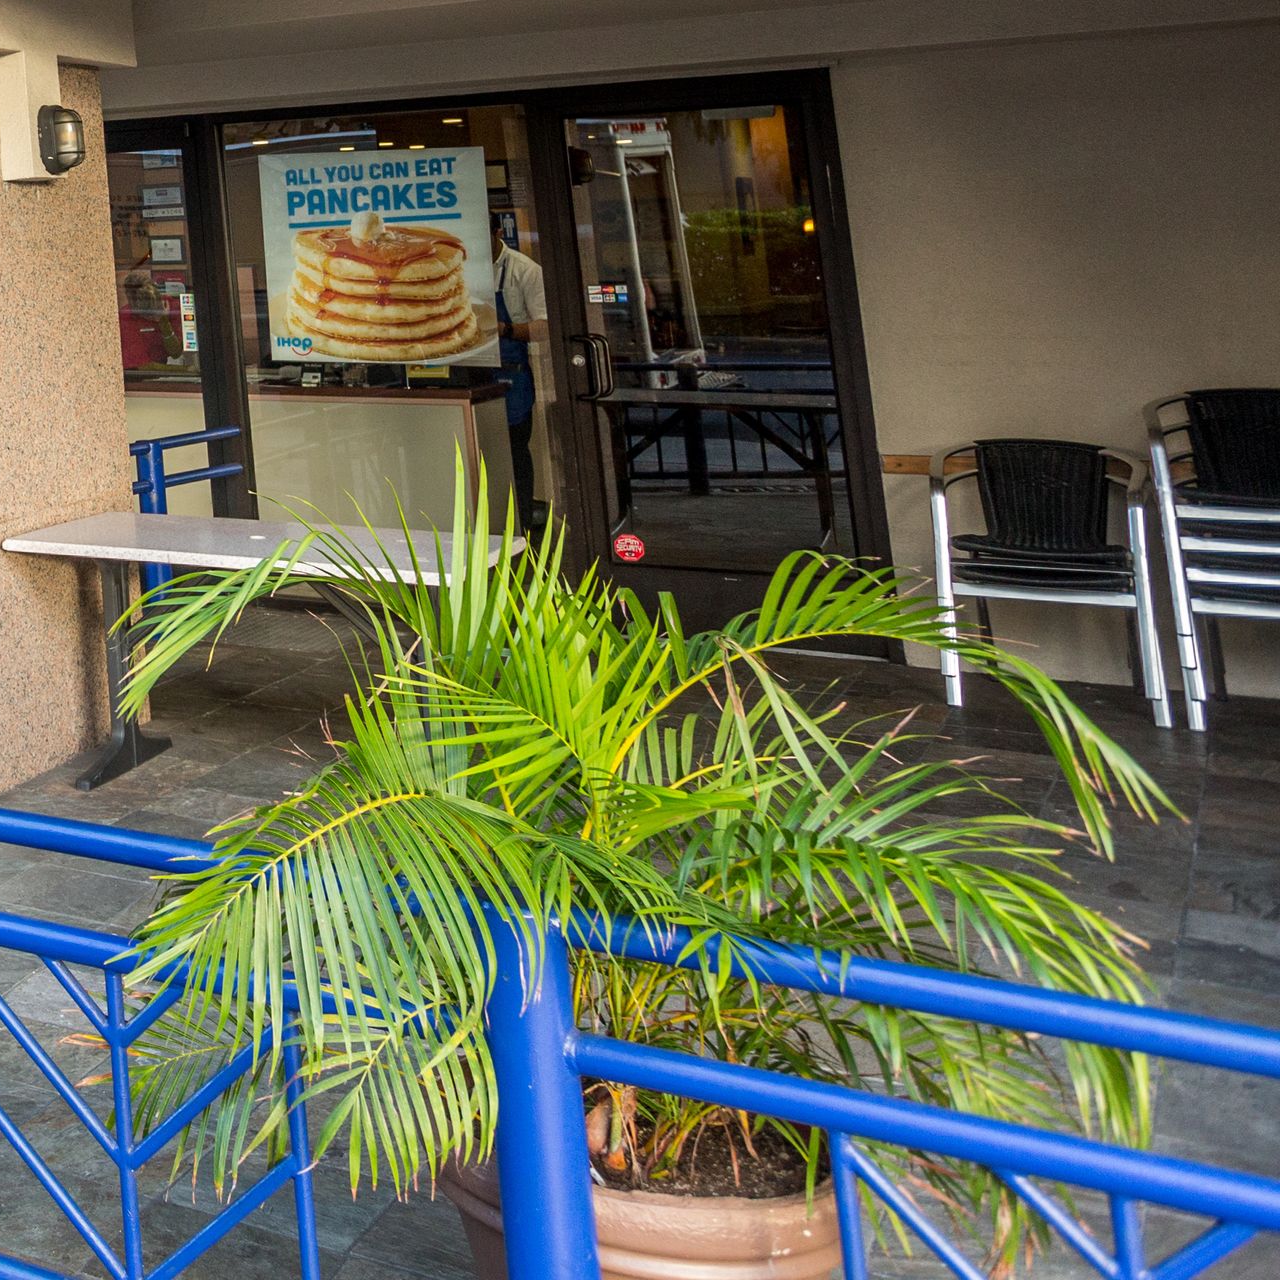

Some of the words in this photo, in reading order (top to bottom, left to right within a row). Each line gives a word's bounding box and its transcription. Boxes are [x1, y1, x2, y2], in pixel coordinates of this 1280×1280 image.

[285, 168, 322, 186] ALL
[324, 164, 364, 183] YOU
[369, 161, 409, 179] CAN
[414, 157, 456, 177] EAT
[287, 181, 458, 216] PANCAKES
[277, 336, 313, 351] IHOP
